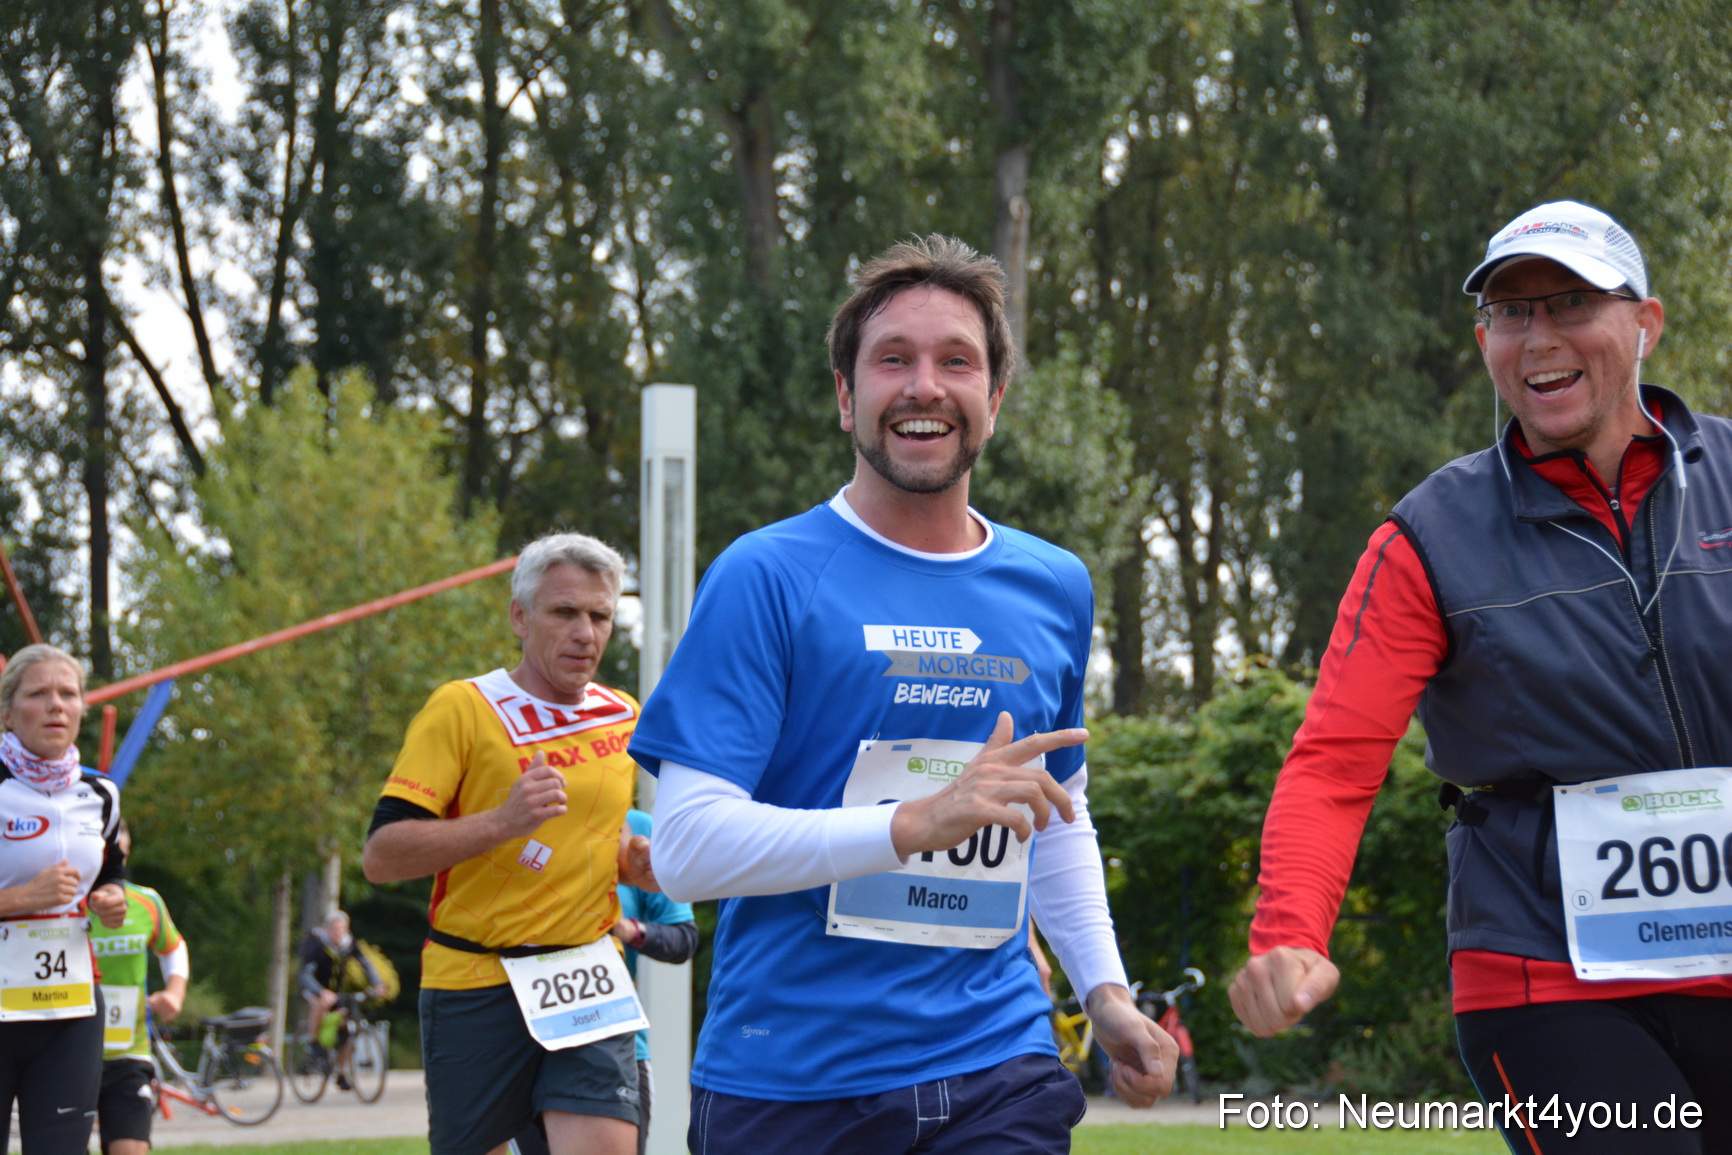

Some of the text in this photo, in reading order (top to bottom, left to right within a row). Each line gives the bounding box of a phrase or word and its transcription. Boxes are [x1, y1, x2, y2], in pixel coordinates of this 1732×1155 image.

[892, 629, 963, 649] HEUTE
[918, 655, 1015, 679] MORGEN
[893, 682, 991, 708] BEWEGEN
[1644, 788, 1722, 809] BOCK
[7, 818, 37, 832] tkn
[1596, 832, 1732, 900] 260
[907, 885, 969, 911] Marco
[1578, 895, 1587, 906] D
[1638, 920, 1732, 943] Clemens
[34, 949, 67, 980] 34
[32, 990, 68, 1002] Martina
[531, 964, 615, 1010] 2628
[571, 1009, 602, 1027] Josef
